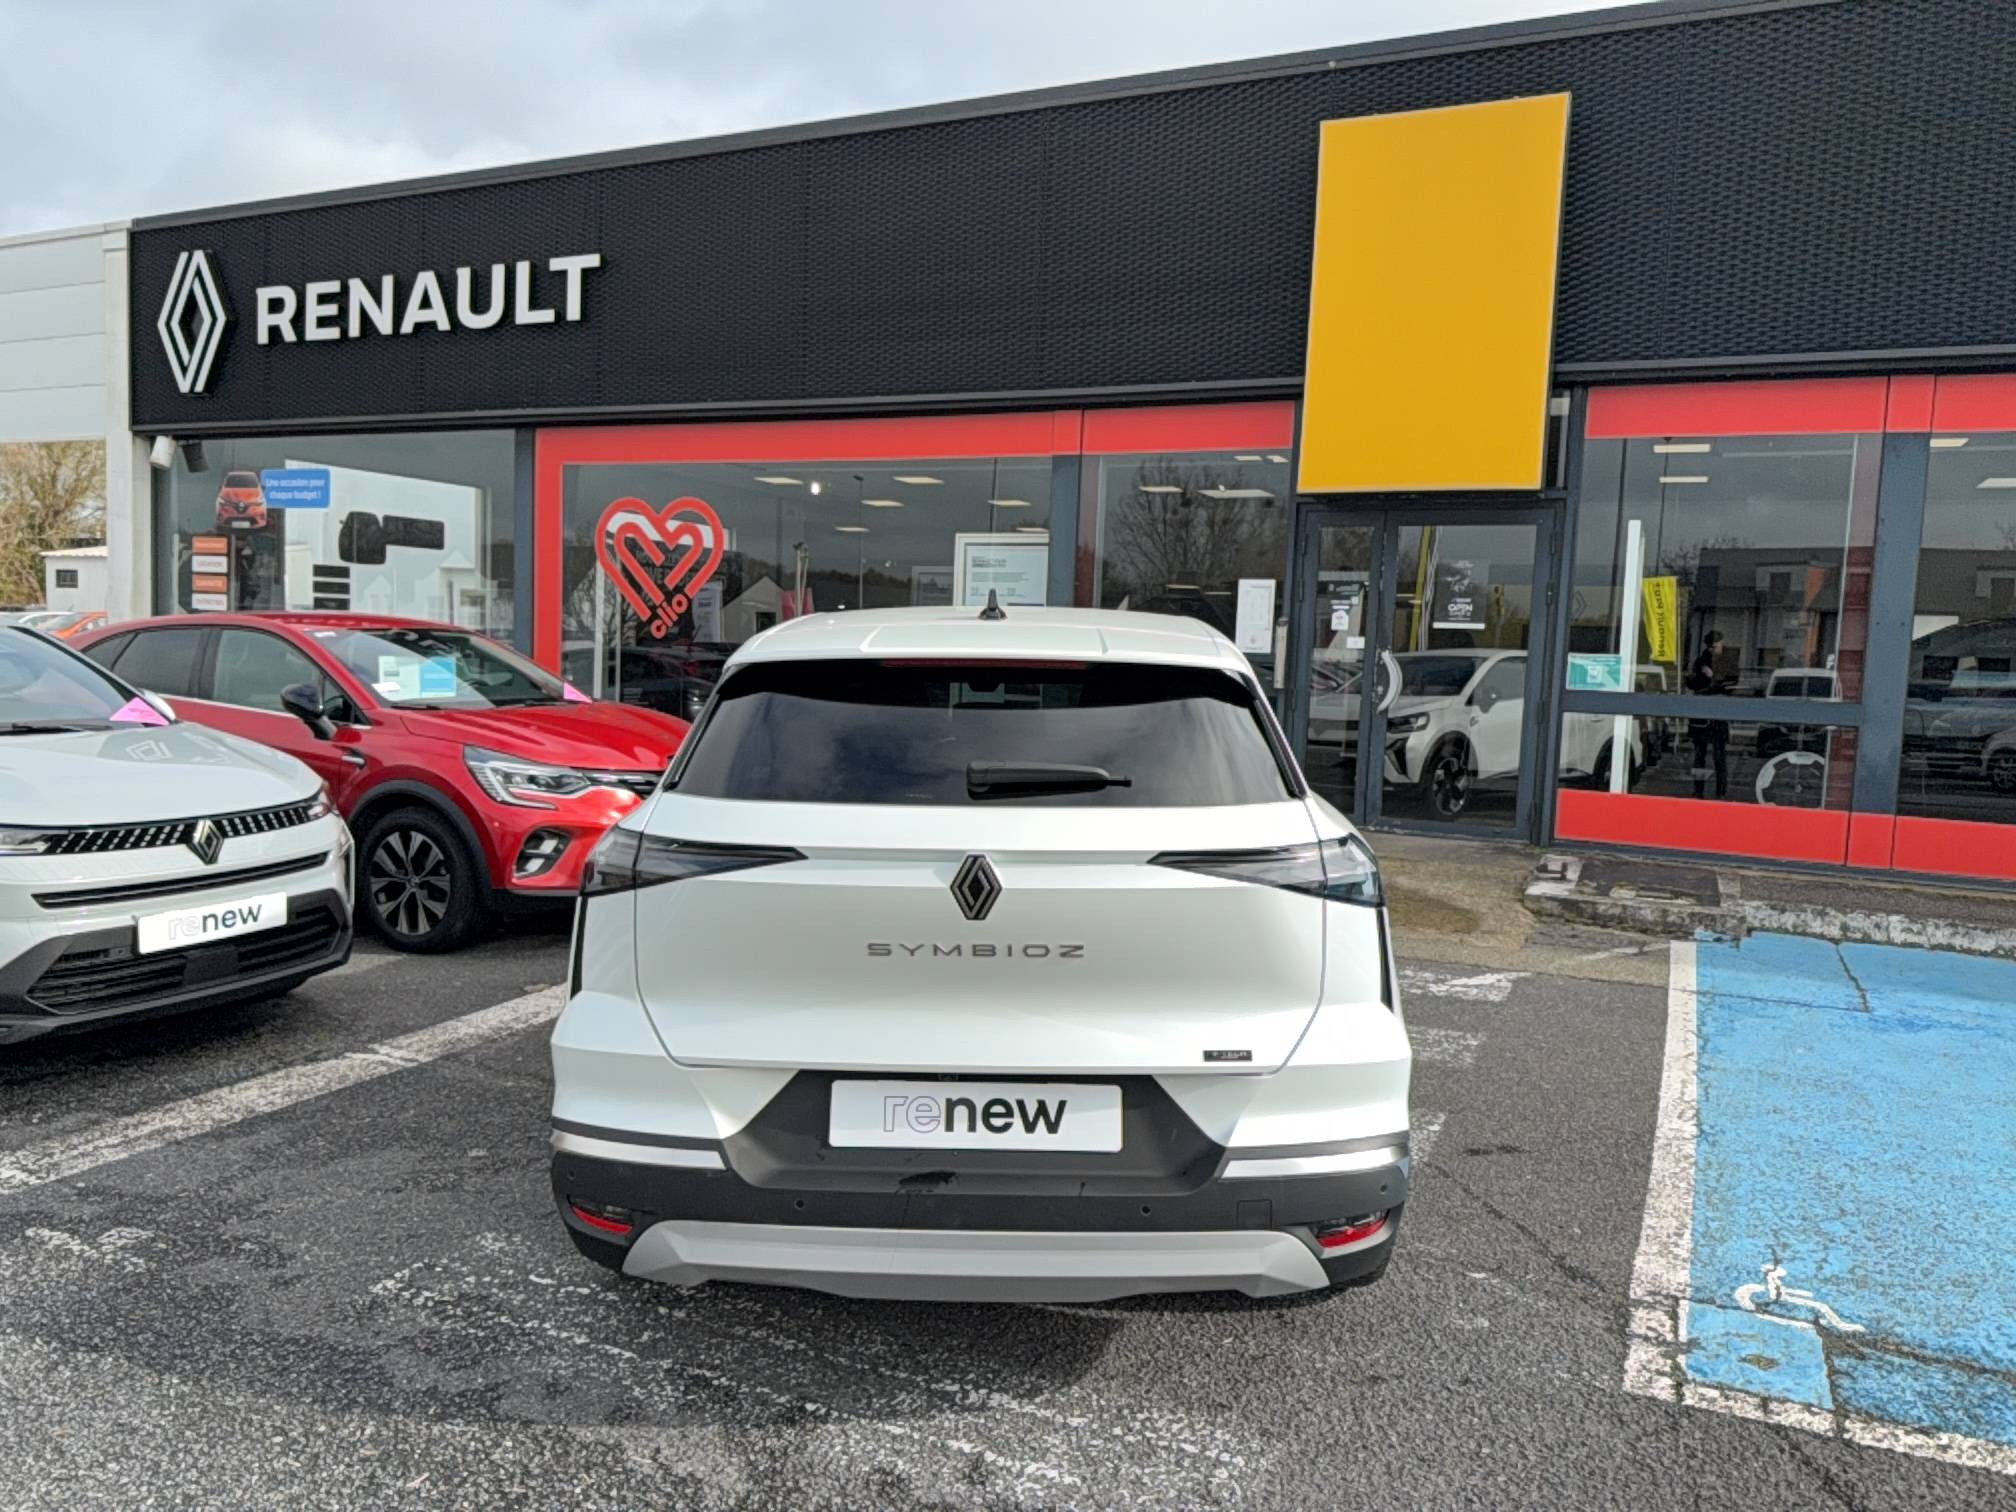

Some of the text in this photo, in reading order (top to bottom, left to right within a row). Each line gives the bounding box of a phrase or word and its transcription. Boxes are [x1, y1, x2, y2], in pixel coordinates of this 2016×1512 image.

[256, 253, 601, 345] RENAULT
[650, 593, 689, 639] clio
[168, 904, 262, 940] renew
[866, 942, 1085, 959] SYMBIOZ
[882, 1095, 1068, 1135] renew
